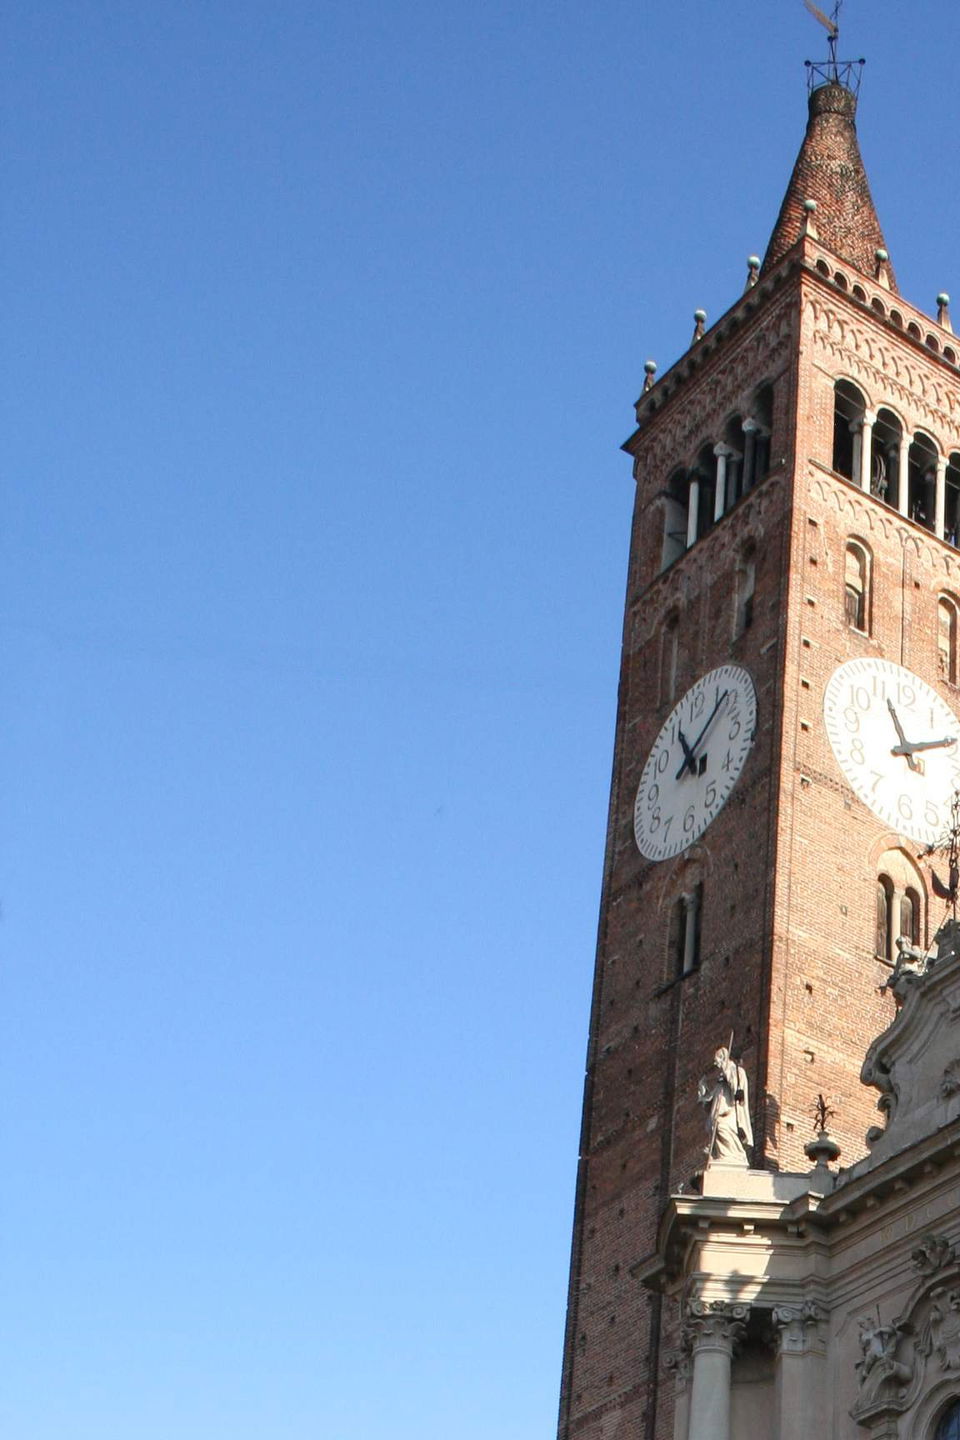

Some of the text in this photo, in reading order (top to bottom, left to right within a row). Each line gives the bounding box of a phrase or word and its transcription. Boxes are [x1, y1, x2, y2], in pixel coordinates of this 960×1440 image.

[850, 685, 871, 711] 10
[872, 676, 886, 700] 11
[897, 682, 916, 712] 12
[690, 692, 705, 723] 12
[844, 707, 859, 733] 9
[671, 719, 682, 745] 11
[731, 711, 741, 740] 3
[653, 749, 669, 780] 10
[721, 748, 733, 772] 4
[850, 738, 865, 765] 8
[704, 780, 717, 808] 5
[870, 770, 885, 792] 7
[647, 784, 660, 811] 9
[898, 794, 912, 820] 6
[650, 807, 661, 834] 8
[683, 805, 695, 833] 6
[924, 800, 939, 827] 5
[664, 814, 674, 843] 7
